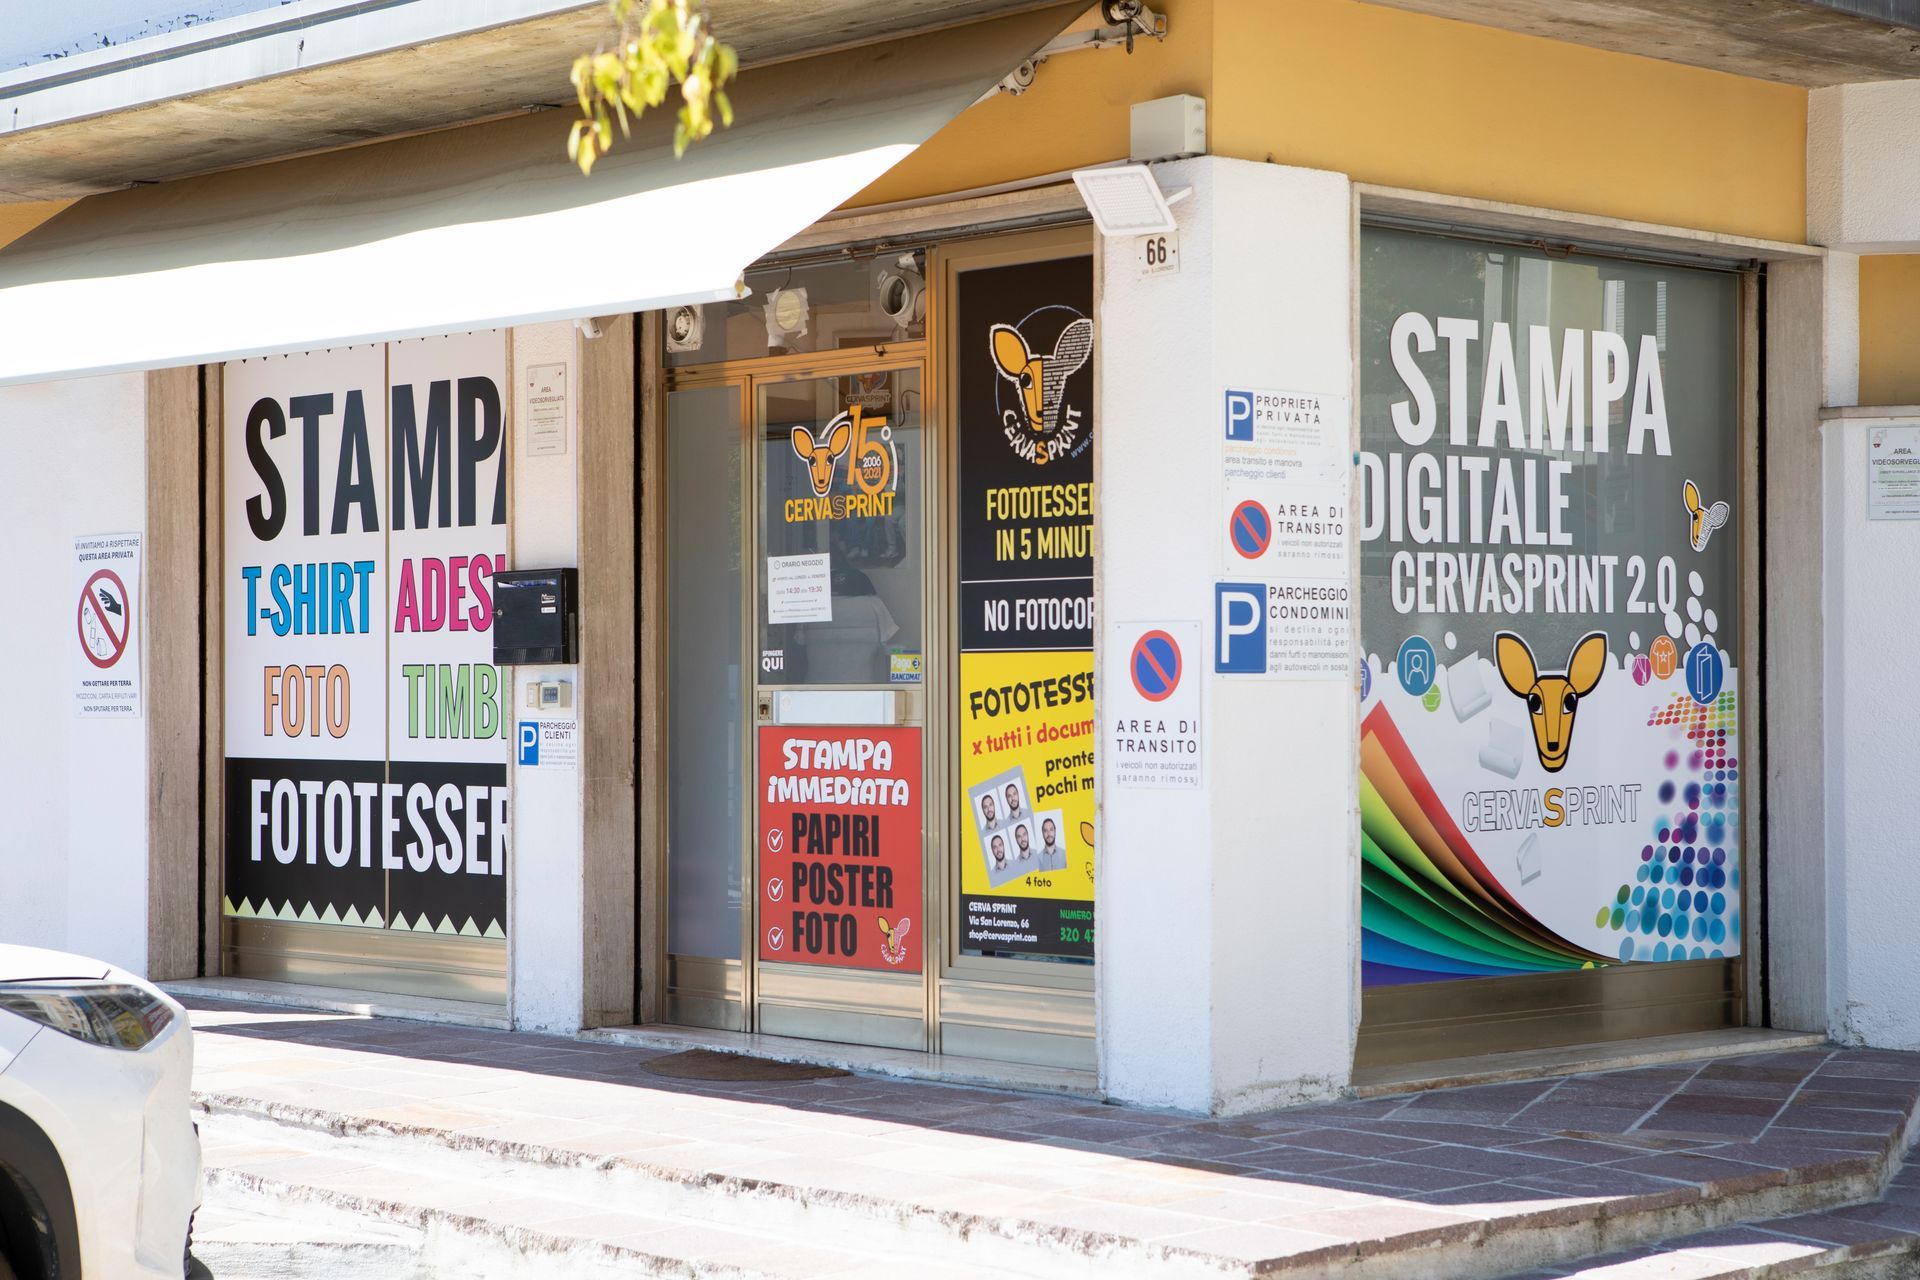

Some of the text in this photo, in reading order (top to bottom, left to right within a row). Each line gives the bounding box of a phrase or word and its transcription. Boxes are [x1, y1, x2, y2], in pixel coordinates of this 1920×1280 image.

[1147, 236, 1166, 266] 66
[1390, 312, 1672, 456] STAMPA
[1256, 410, 1320, 424] PRIVATA
[863, 456, 882, 468] 2006
[1224, 456, 1240, 464] area
[1242, 457, 1266, 466] transito
[864, 466, 882, 479] 2021
[1224, 468, 1264, 480] parcheggio
[1360, 452, 1572, 545] DIGITALE
[784, 491, 896, 522] CERVASPRINT
[1278, 504, 1344, 518] AREA DI
[1278, 522, 1343, 536] TRANSITO
[110, 538, 140, 548] RISPETTARE
[996, 529, 1014, 562] IN
[1020, 528, 1032, 560] 5
[78, 553, 98, 562] QUESTA
[112, 551, 134, 559] PRIVATA
[1391, 550, 1678, 615] CERVASPRINT 2.0
[242, 560, 375, 636] T-SHIRT
[394, 554, 506, 632] ADES
[1270, 586, 1348, 601] PARCHEGGIO
[984, 600, 1010, 632] NO
[1270, 606, 1349, 620] CONDOMINI
[1284, 625, 1322, 634] declina
[1336, 640, 1349, 649] per
[762, 657, 784, 672] QUI
[891, 673, 920, 681] BANCOMAT
[264, 664, 350, 738] FOTO
[402, 663, 507, 740] TIMB
[540, 722, 576, 730] PARCHEGGIO
[1116, 720, 1196, 734] AREA DI
[544, 731, 571, 740] CLIENTI
[972, 740, 982, 755] x
[986, 726, 1022, 753] tutti
[1026, 725, 1032, 746] i
[1116, 739, 1197, 753] TRANSITO
[782, 738, 893, 771] STAMPA
[1046, 750, 1094, 777] pronte
[1120, 761, 1142, 769] veicoli
[1160, 762, 1198, 770] autorizzati
[1116, 774, 1156, 782] saranno
[1036, 774, 1078, 803] pochi
[1462, 784, 1642, 832] CERVASPRINT
[792, 812, 879, 857] PAPIRI
[792, 862, 893, 908] POSTER
[1026, 876, 1052, 887] 4 foto
[968, 901, 1018, 914] CERVA SPRINT
[1060, 909, 1092, 920] NUMERO
[968, 915, 1030, 929] Via San Lorenzo, 66
[792, 911, 857, 957] FOTO
[968, 929, 1038, 943] shop@cervasprint.com
[1060, 927, 1080, 942] 320
